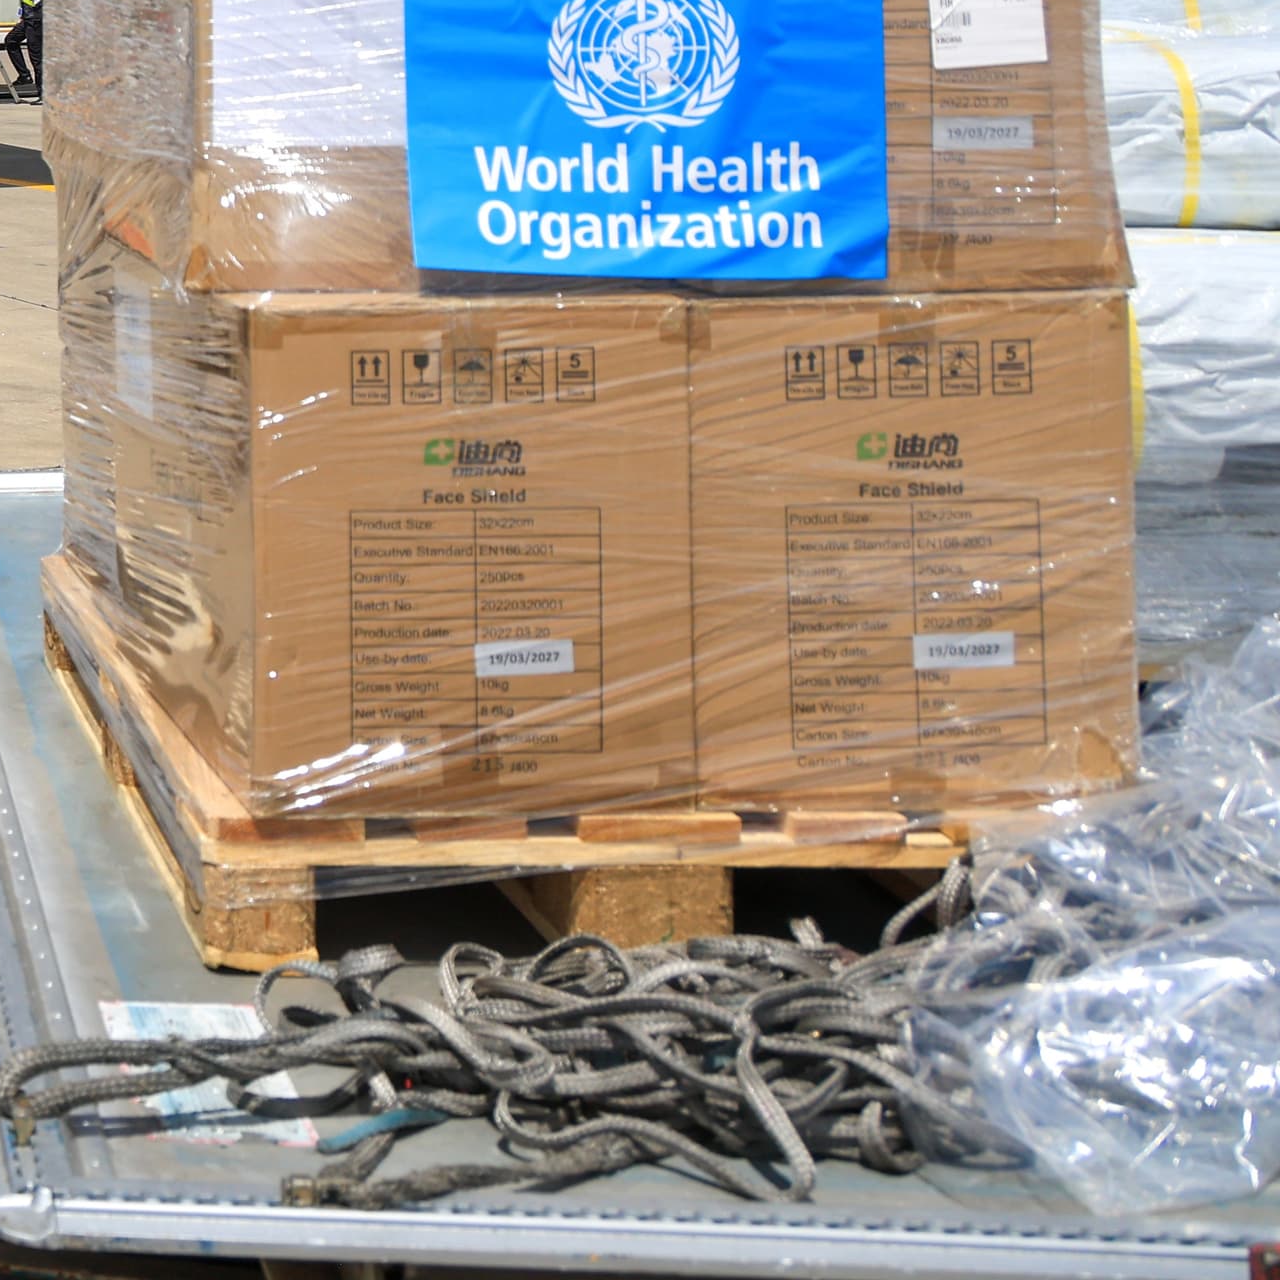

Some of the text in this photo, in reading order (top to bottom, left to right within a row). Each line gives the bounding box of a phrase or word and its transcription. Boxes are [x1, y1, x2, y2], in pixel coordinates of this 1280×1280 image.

[947, 126, 1020, 140] 19/03/2027
[474, 141, 821, 193] World Health
[476, 199, 824, 261] Organization
[1006, 345, 1017, 361] 5
[569, 353, 581, 369] 5
[894, 433, 959, 458] 迪尚
[859, 481, 964, 498] Face Shield
[423, 489, 465, 505] Face
[353, 519, 401, 531] Product
[790, 512, 838, 526] Product
[353, 544, 474, 558] Executive Standard
[790, 541, 850, 554] Executive
[355, 627, 419, 639] Production
[792, 621, 858, 633] Production
[489, 651, 560, 665] 19/03/2027
[928, 644, 1000, 658] 19/03/2027
[355, 682, 391, 693] Gross
[480, 678, 509, 693] 10kg
[794, 676, 831, 688] Gross
[355, 708, 377, 720] Net
[795, 703, 816, 714] Net
[796, 730, 837, 742] Carton
[797, 757, 840, 769] Carton
